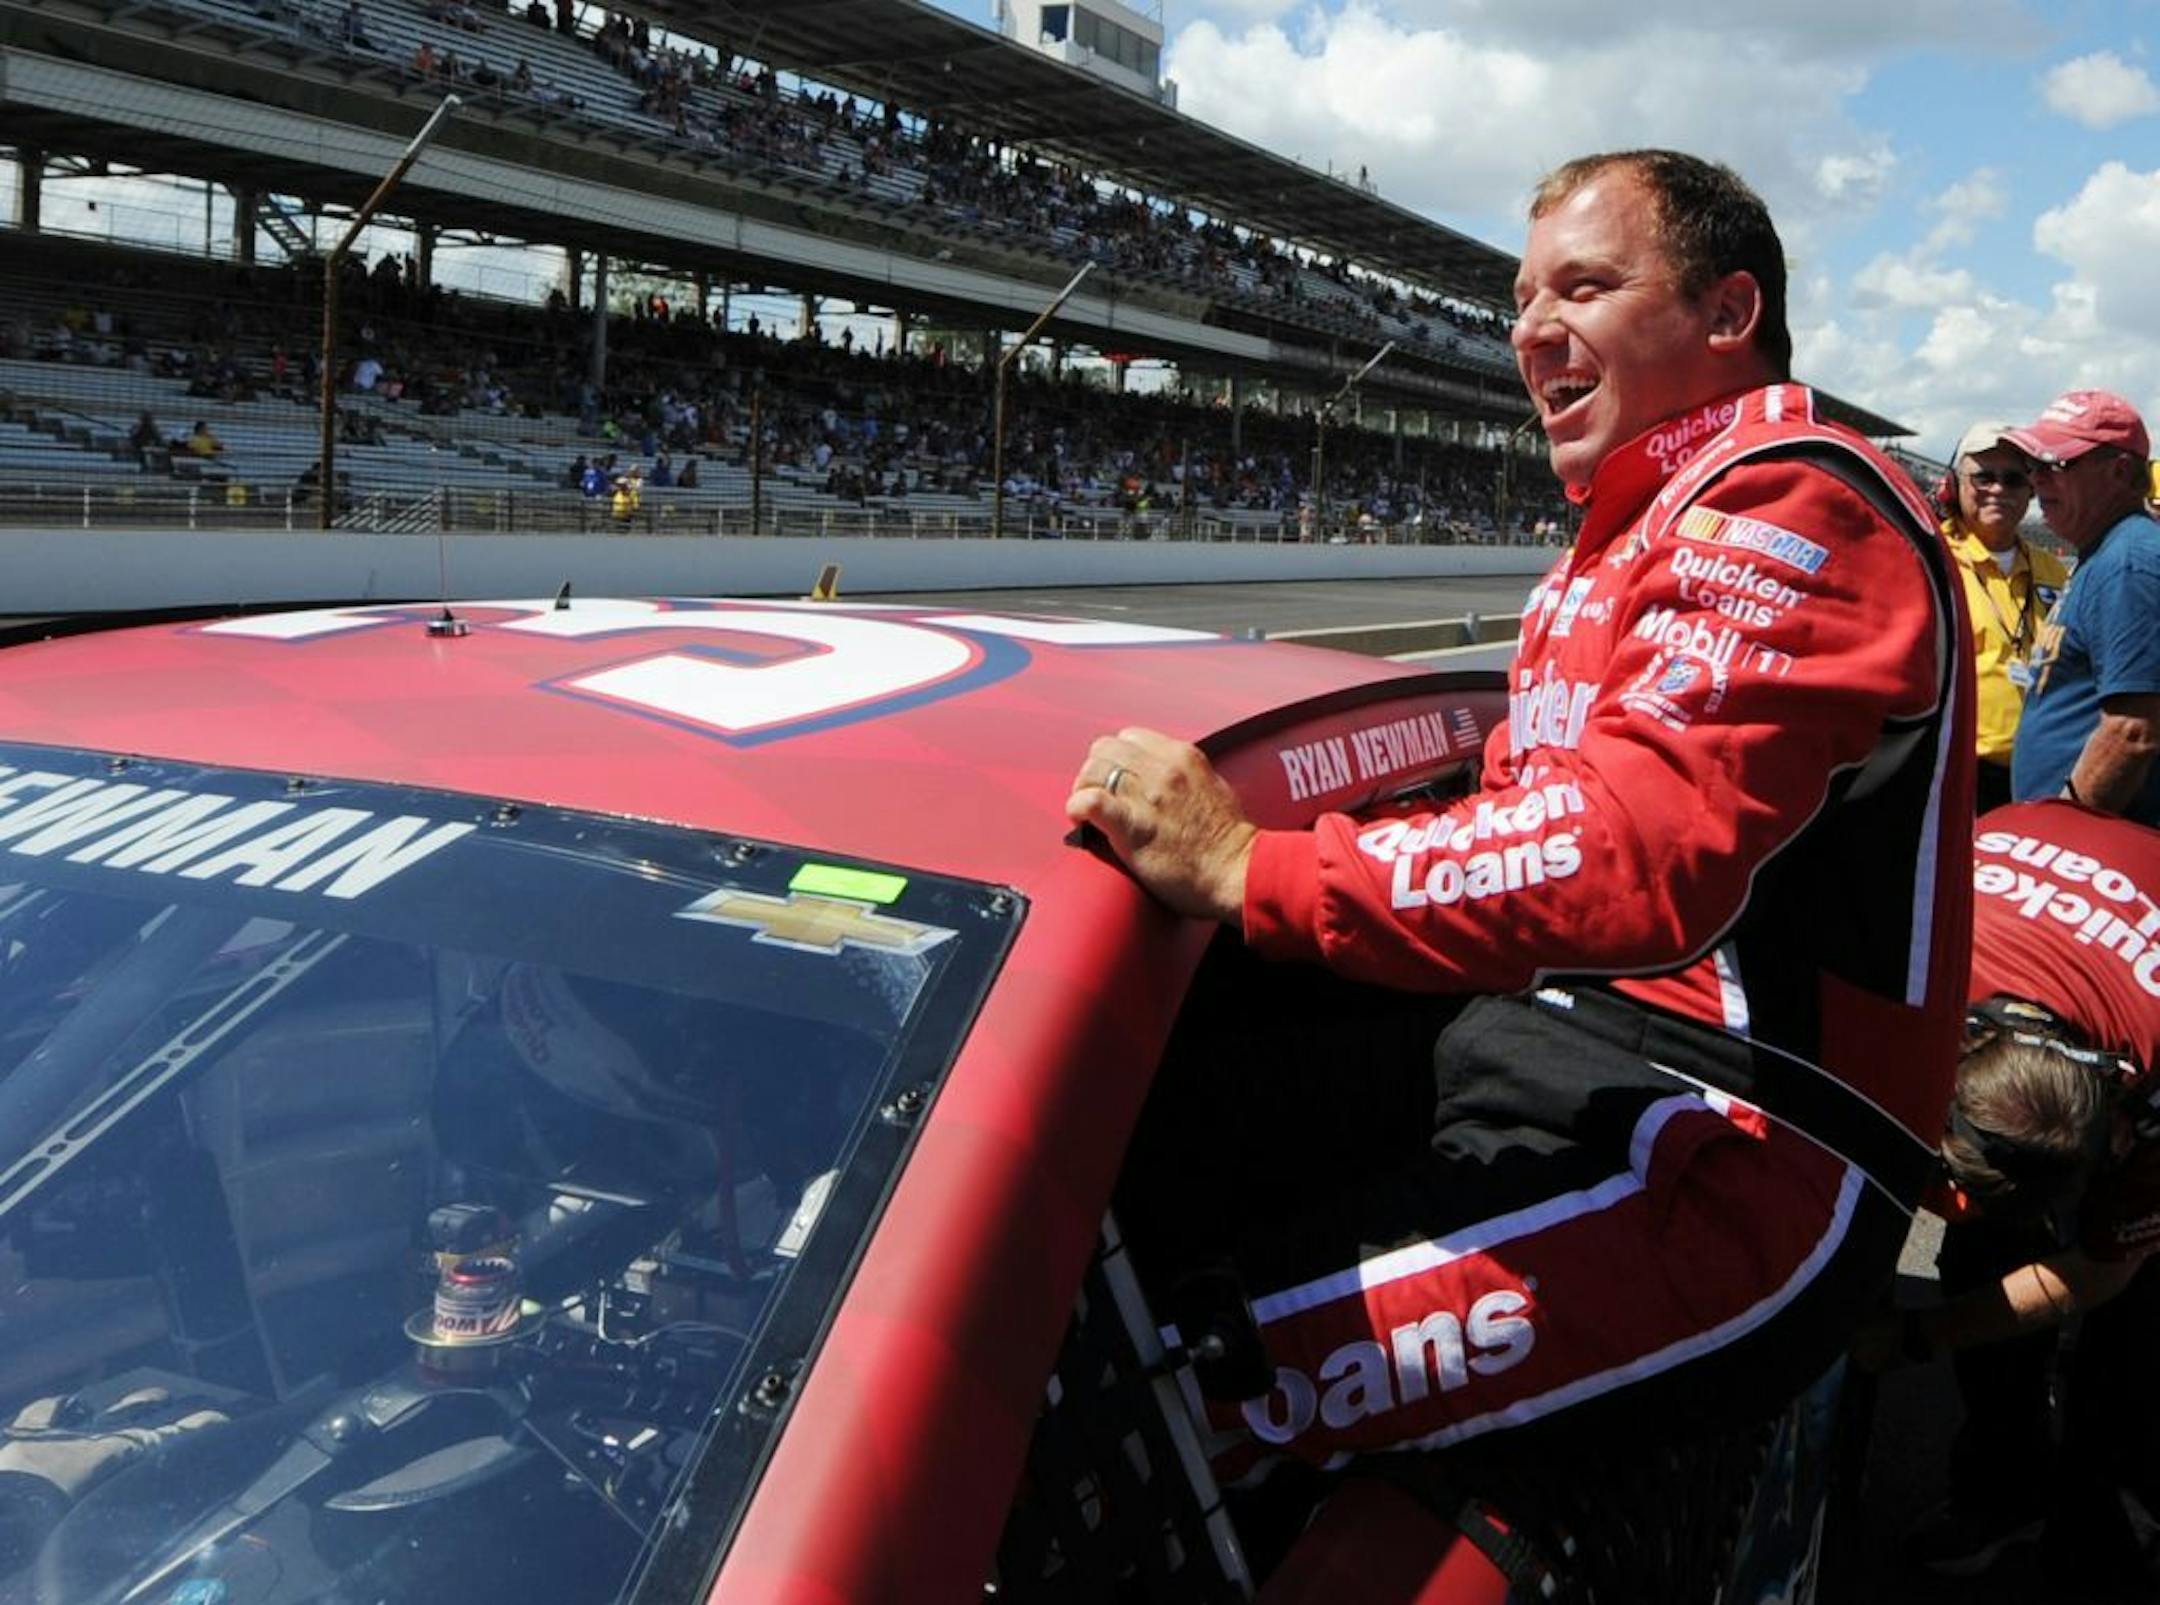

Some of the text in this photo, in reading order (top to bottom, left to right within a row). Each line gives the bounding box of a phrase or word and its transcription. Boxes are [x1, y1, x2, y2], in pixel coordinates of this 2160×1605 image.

[1724, 518, 1827, 571] NASCAR
[1670, 547, 1804, 609] Quicken
[1680, 577, 1776, 629] Loans
[1633, 605, 1742, 668] Mobil
[1279, 711, 1450, 802] RYAN NEWMAN
[1357, 780, 1585, 862] Quicken
[1391, 832, 1583, 910] Loans
